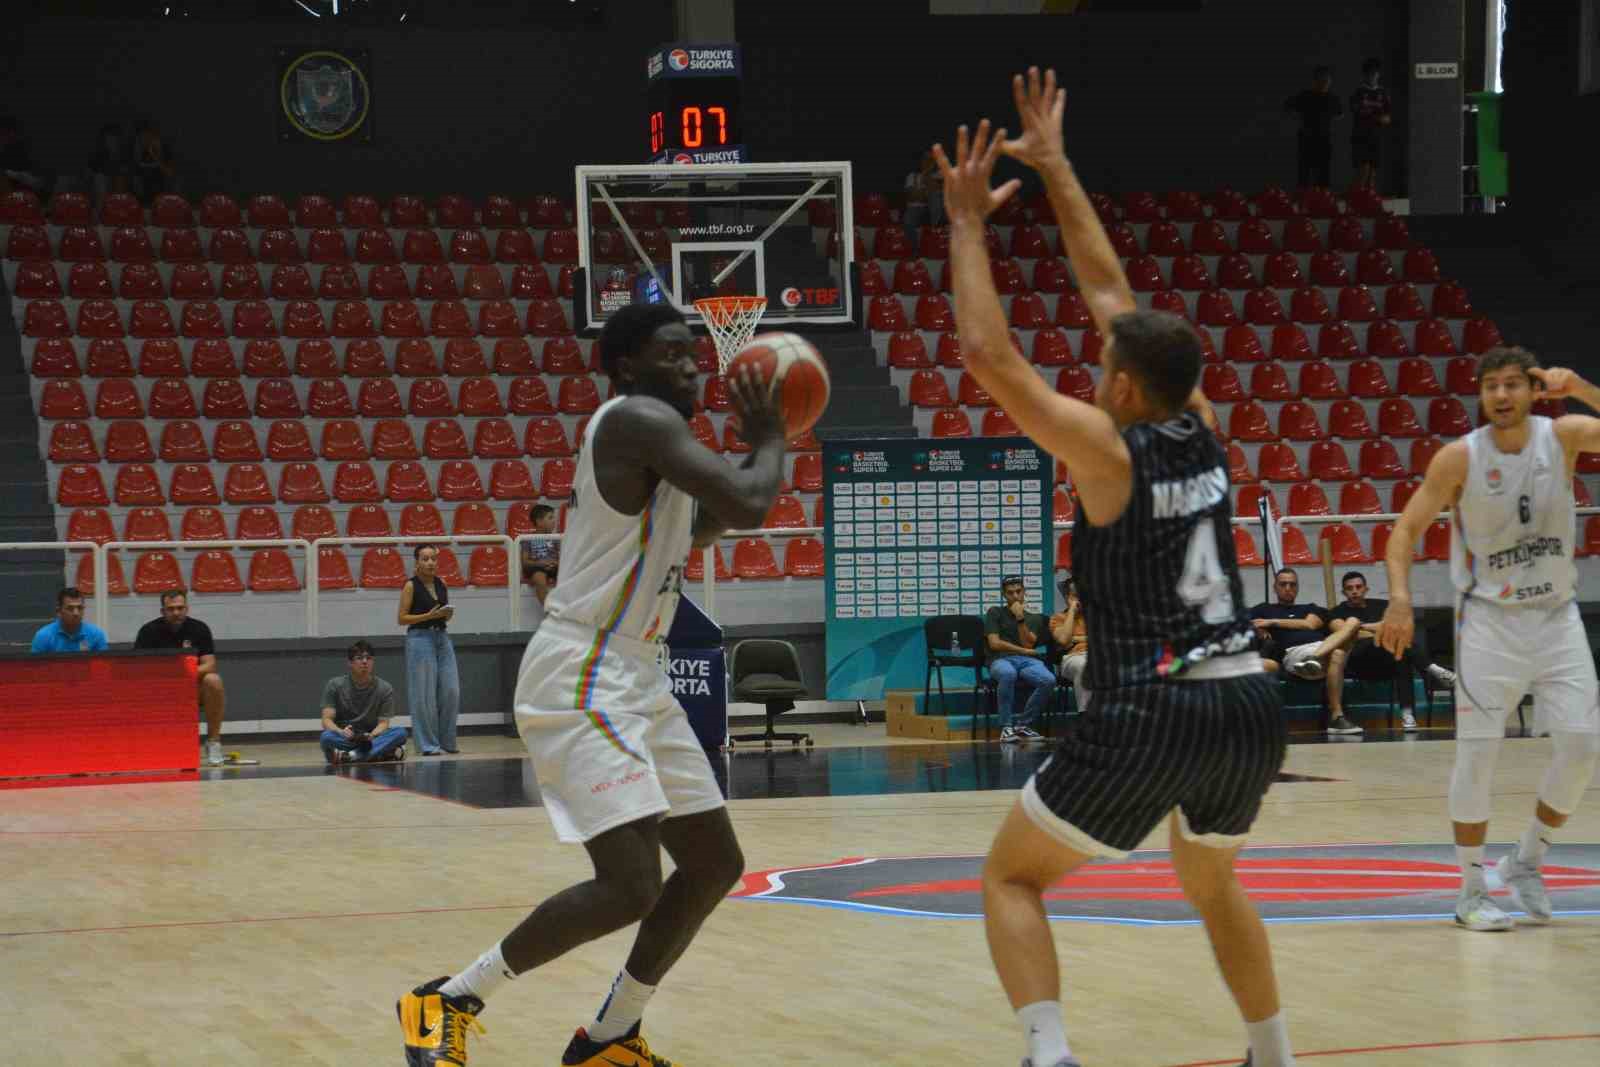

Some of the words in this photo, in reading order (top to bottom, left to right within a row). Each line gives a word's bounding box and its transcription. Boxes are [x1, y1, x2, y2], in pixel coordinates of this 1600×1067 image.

[683, 106, 726, 147] 07
[679, 223, 754, 235] www.tbf.org.tr
[802, 288, 840, 305] TBF
[1519, 495, 1530, 524] 6
[1176, 517, 1236, 624] 4
[1517, 582, 1553, 600] STAR
